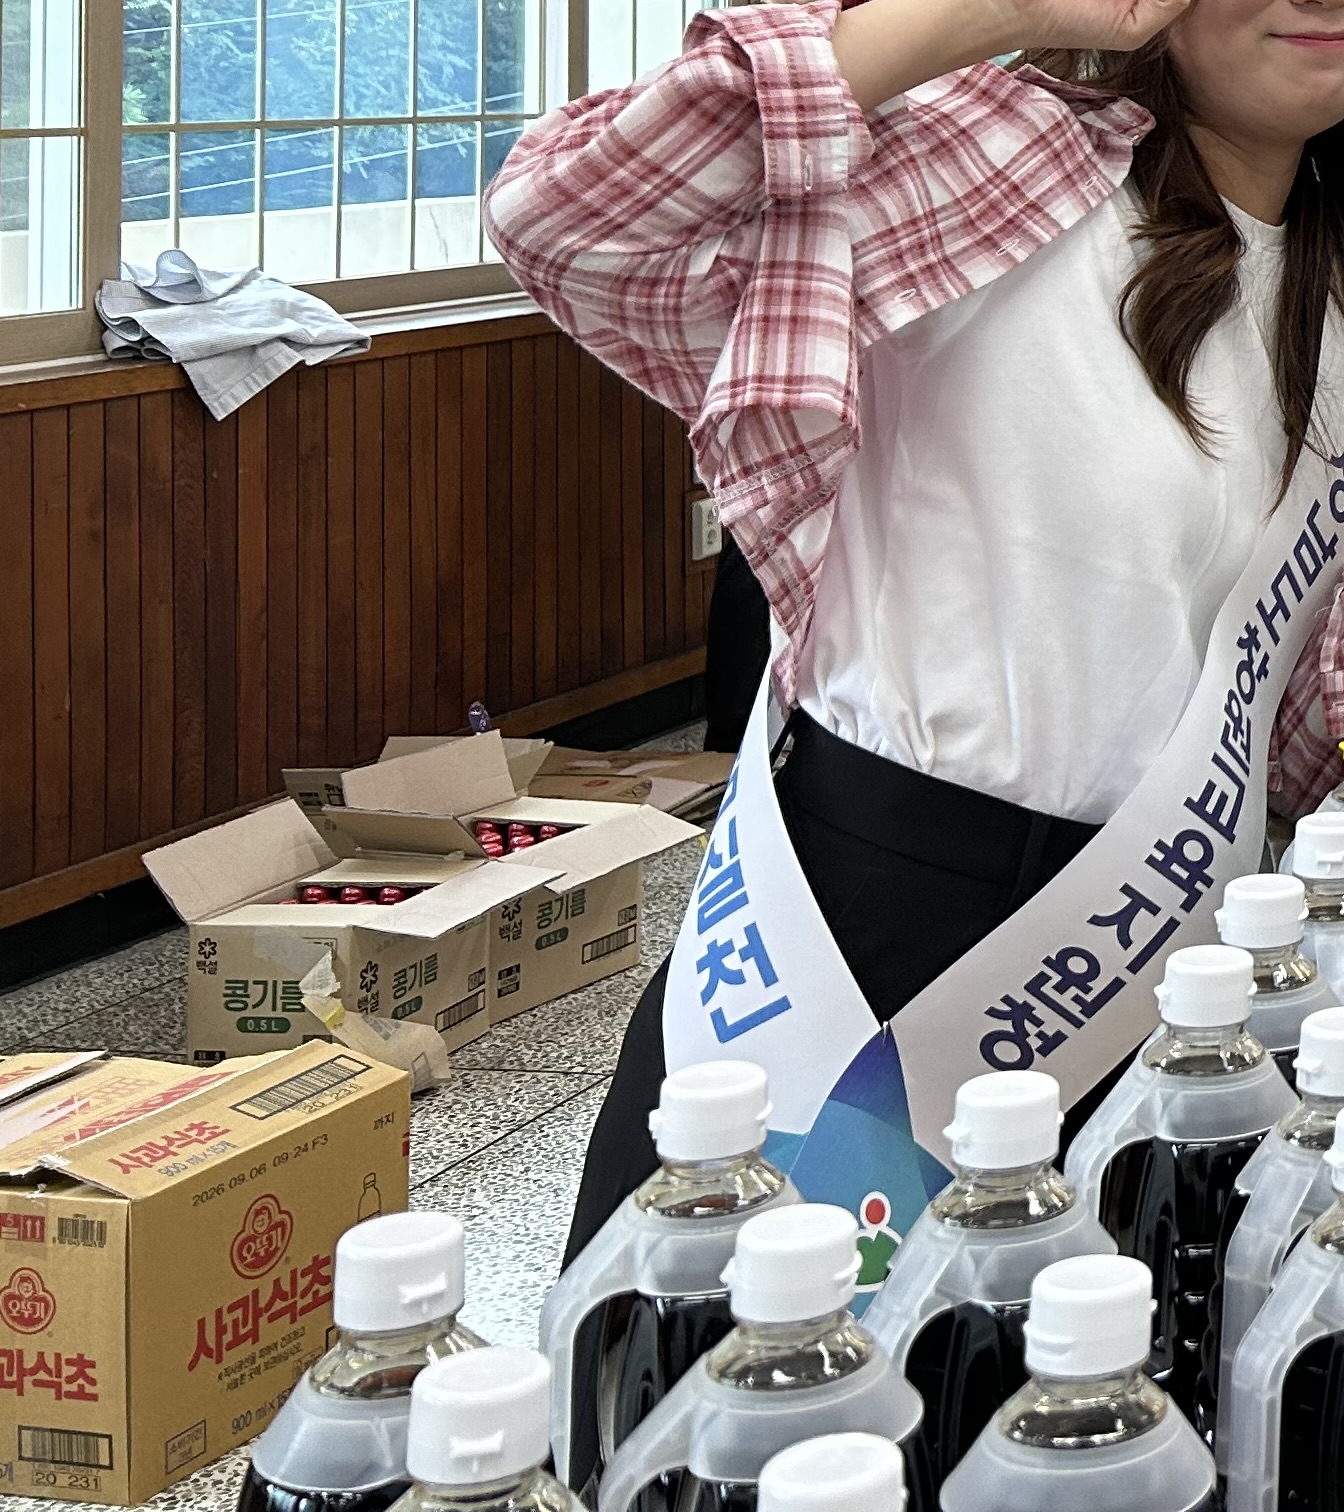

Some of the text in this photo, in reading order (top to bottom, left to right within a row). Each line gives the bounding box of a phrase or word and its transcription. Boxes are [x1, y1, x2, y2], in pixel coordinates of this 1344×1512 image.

[536, 888, 586, 930] 콩기름
[499, 919, 523, 943] 백설
[195, 960, 218, 975] 백설
[392, 952, 439, 1000] 콩기름
[222, 979, 306, 1013] 콩기름
[247, 1019, 280, 1031] 0.5 L
[107, 1120, 232, 1175] 사과식초
[241, 1226, 285, 1266] 오뚜기
[8, 1299, 46, 1320] 오뚜기
[187, 1254, 334, 1373] 사과식초
[232, 1409, 252, 1435] 900
[35, 1472, 101, 1490] 20 231
